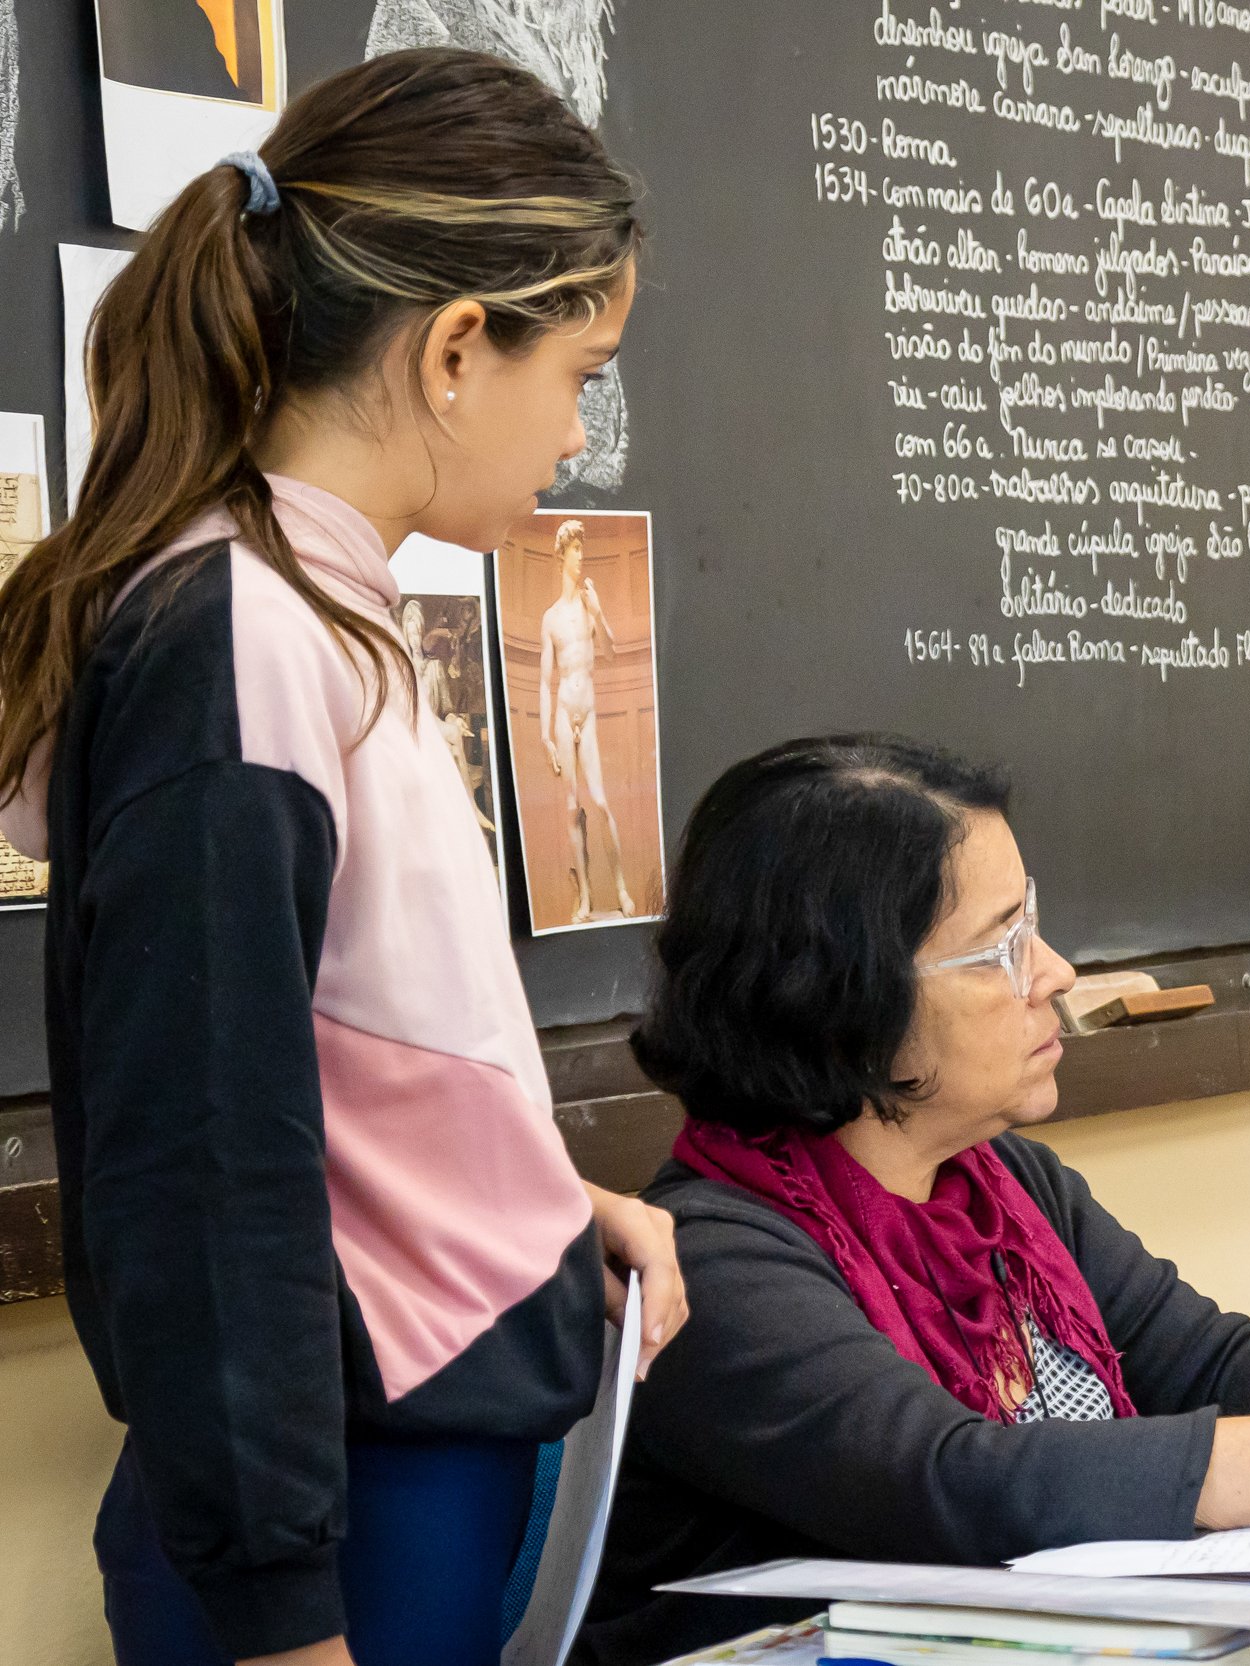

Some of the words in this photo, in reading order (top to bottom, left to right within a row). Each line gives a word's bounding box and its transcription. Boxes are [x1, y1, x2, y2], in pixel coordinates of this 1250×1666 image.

[874, 0, 977, 54] desenhou
[982, 18, 1048, 96] igreja
[1056, 22, 1101, 75] San
[876, 55, 986, 113] mármore
[991, 170, 1015, 216] de
[1096, 178, 1158, 243] Capela
[883, 214, 941, 266] atrás
[947, 227, 1002, 274] altar
[1017, 227, 1090, 275] homens
[1094, 230, 1180, 300] julgados
[991, 282, 1067, 340] quedas
[1085, 285, 1177, 326] andaime
[884, 322, 951, 360] visão
[958, 328, 984, 363] do
[987, 325, 1023, 383] fim
[1027, 329, 1057, 366] do
[1060, 327, 1132, 364] mundo
[887, 375, 927, 410] viu
[940, 377, 988, 412] caiu
[1070, 373, 1176, 430] implorando
[895, 432, 937, 458] com
[1011, 426, 1089, 461] Nunca
[1096, 435, 1118, 459] se
[1109, 464, 1224, 527] arquitetura
[995, 519, 1061, 583] grande
[1067, 517, 1140, 577] cúpula
[1145, 522, 1198, 584] igreja
[1206, 520, 1244, 560] São
[1100, 577, 1188, 624] dedicado
[1010, 628, 1068, 689] falece
[1068, 629, 1127, 664] Roma
[1141, 626, 1231, 684] sepultado
